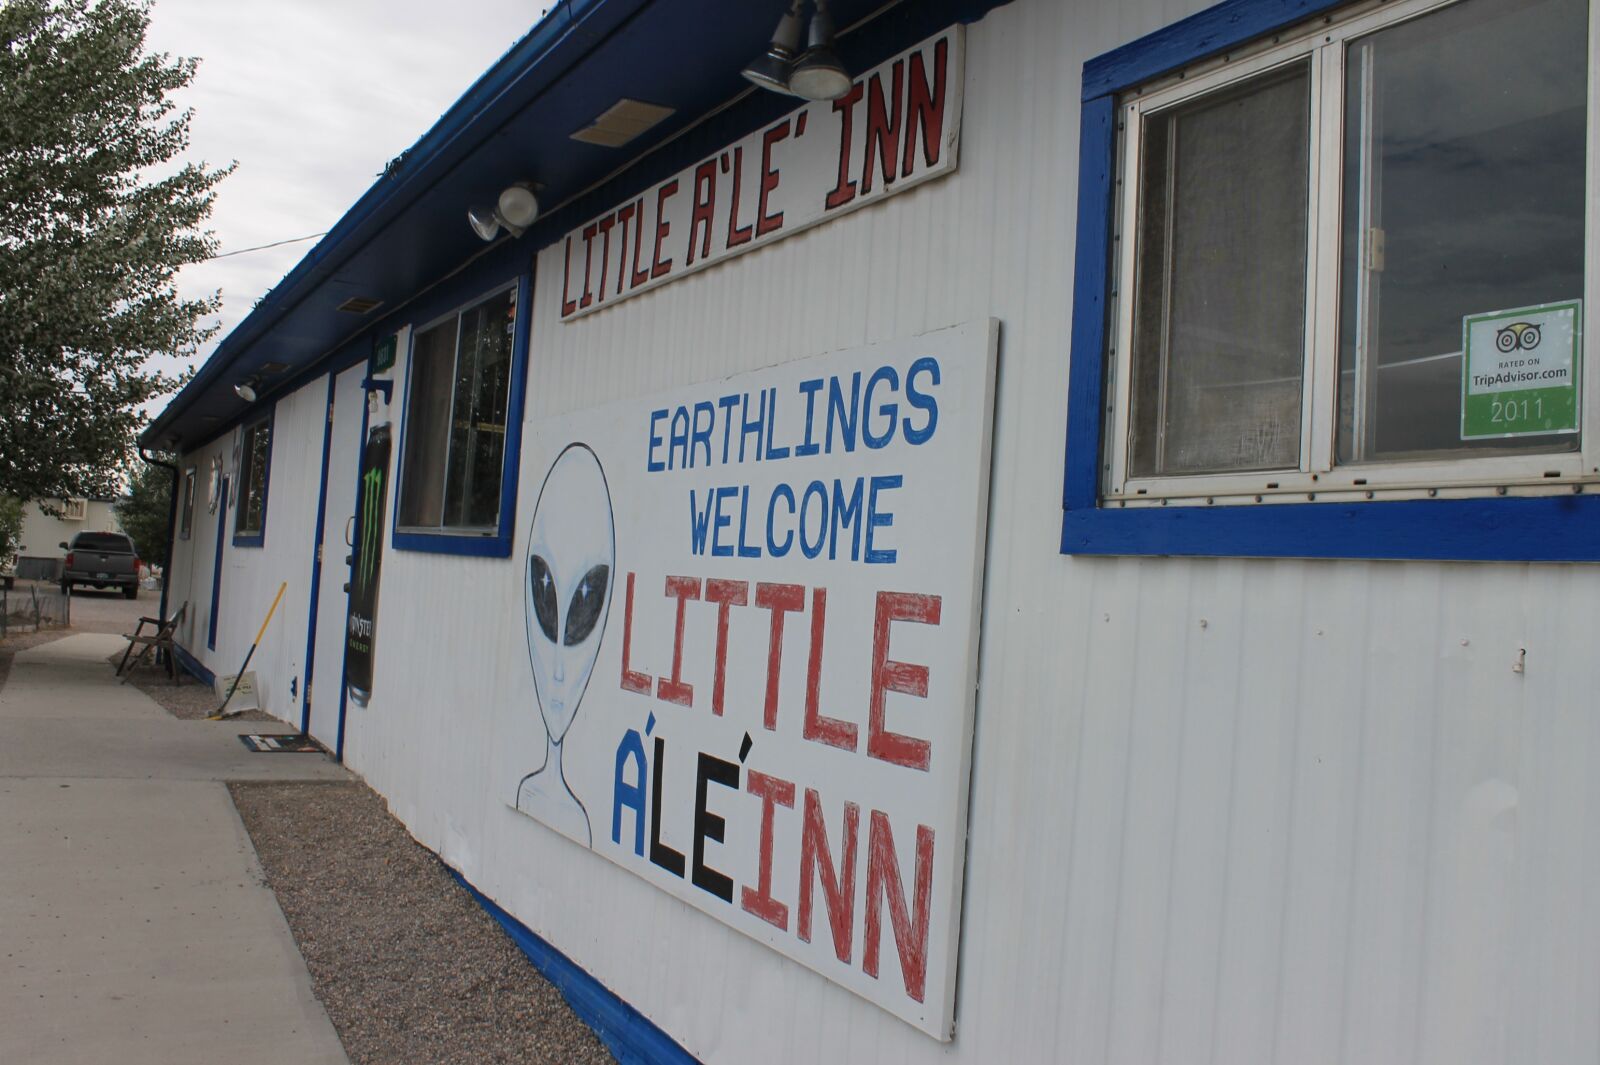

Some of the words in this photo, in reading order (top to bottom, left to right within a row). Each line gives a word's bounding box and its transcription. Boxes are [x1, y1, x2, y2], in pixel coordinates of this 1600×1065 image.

[561, 179, 678, 317] LITTLE
[825, 37, 949, 210] INN
[1473, 368, 1567, 387] TripAdvisor.com
[1498, 360, 1525, 369] RATED
[1527, 358, 1540, 366] ON
[647, 357, 941, 473] EARTHLINGS
[1491, 398, 1542, 422] 2011
[690, 475, 903, 564] WELCOME
[620, 572, 942, 771] LITTLE
